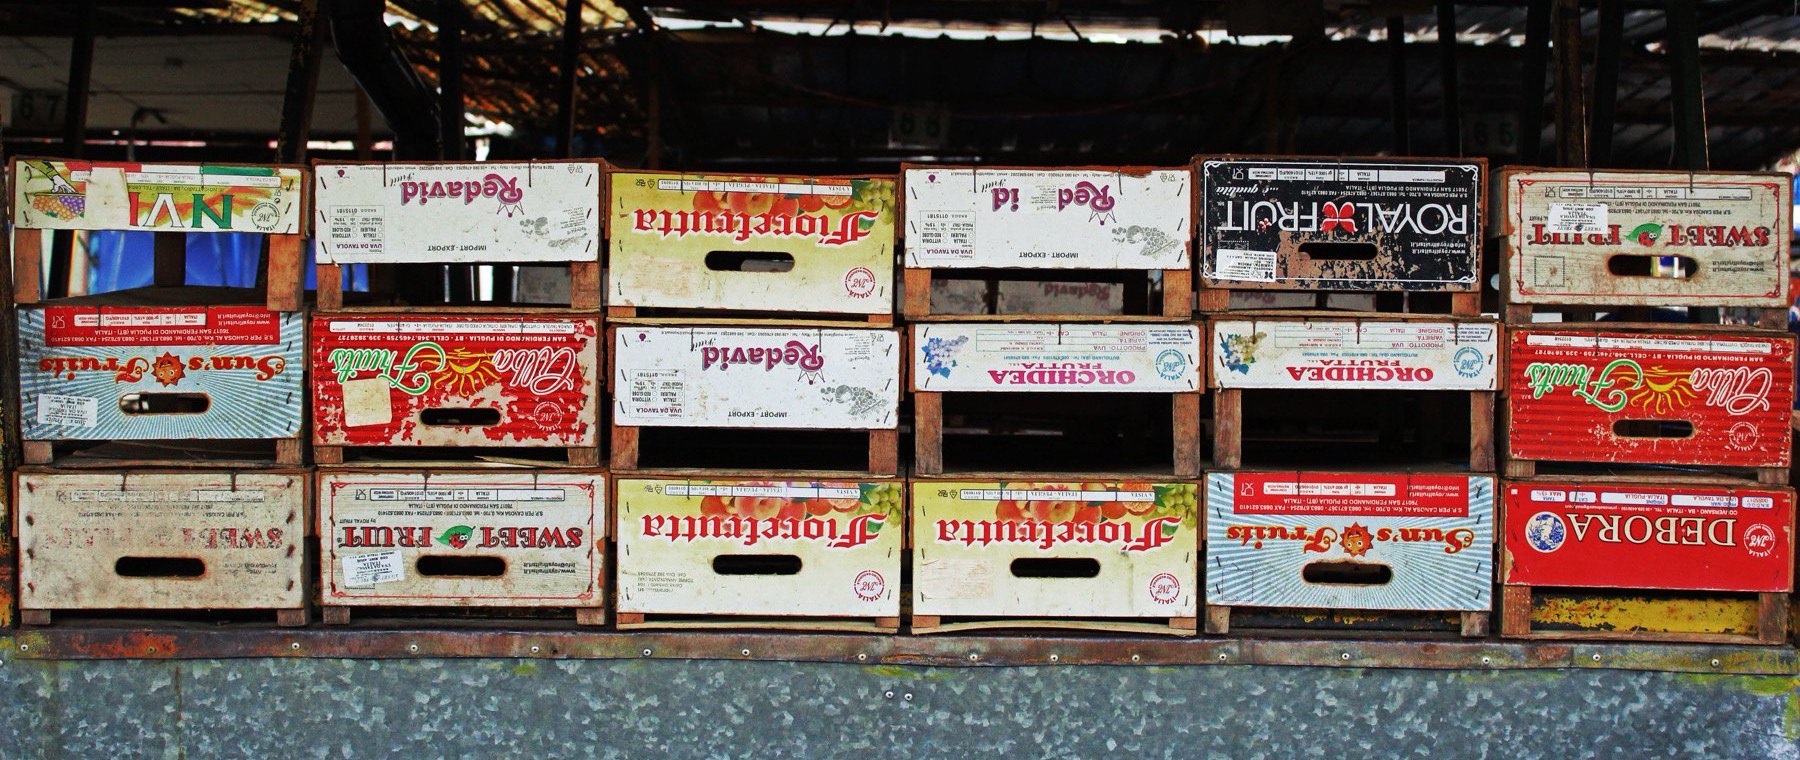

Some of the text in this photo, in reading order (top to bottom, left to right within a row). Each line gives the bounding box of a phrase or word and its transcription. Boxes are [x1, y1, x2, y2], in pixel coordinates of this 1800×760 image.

[399, 174, 523, 205] Redavid
[1216, 184, 1258, 196] qualità
[634, 209, 879, 245] Fiorefrutta
[1217, 200, 1467, 234] ROYAL FRUIT
[1665, 226, 1770, 247] SWEET
[848, 290, 871, 298] ITALIA
[328, 342, 575, 396] Alba Fruits
[701, 341, 824, 372] Redavid
[39, 356, 285, 384] Sun's Fruits
[987, 370, 1135, 384] ORCHIDEA
[1160, 372, 1182, 380] ITALIA
[1286, 367, 1433, 382] ORCHIDEA
[1458, 370, 1479, 378] ITALIA
[1524, 359, 1772, 415] Alba Fruits
[338, 526, 583, 549] SWEET FRUIT
[642, 514, 887, 548] Fiorefrutta
[936, 516, 1182, 551] Fiorefrutta
[1227, 526, 1474, 554] Sun's Fruits
[1566, 514, 1737, 546] DEBORA
[1748, 549, 1770, 557] ITALIA
[858, 593, 880, 602] ITALIA
[1154, 596, 1176, 605] ITALIA
